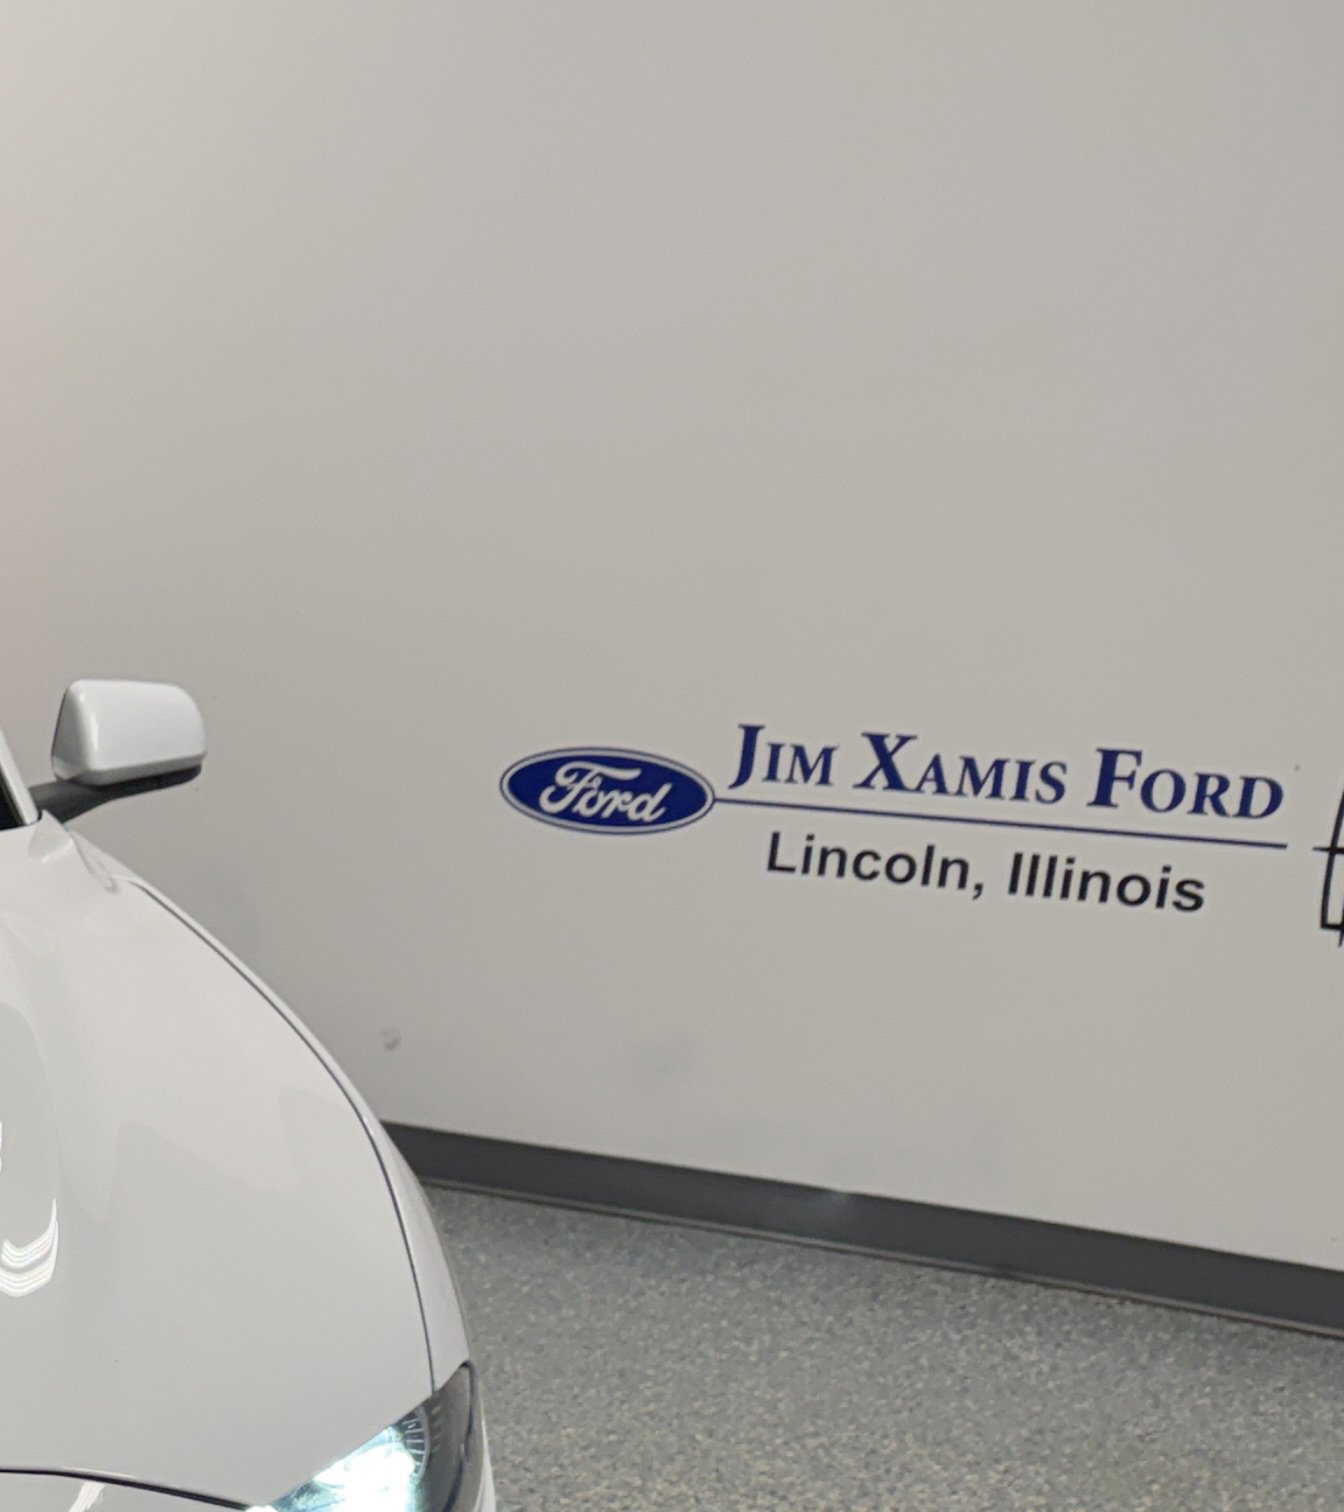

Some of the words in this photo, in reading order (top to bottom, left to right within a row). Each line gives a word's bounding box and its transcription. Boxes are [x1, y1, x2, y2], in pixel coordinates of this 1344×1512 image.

[539, 762, 670, 822] Ford
[767, 831, 985, 900] Lincoln,
[1008, 852, 1205, 913] Illinois
